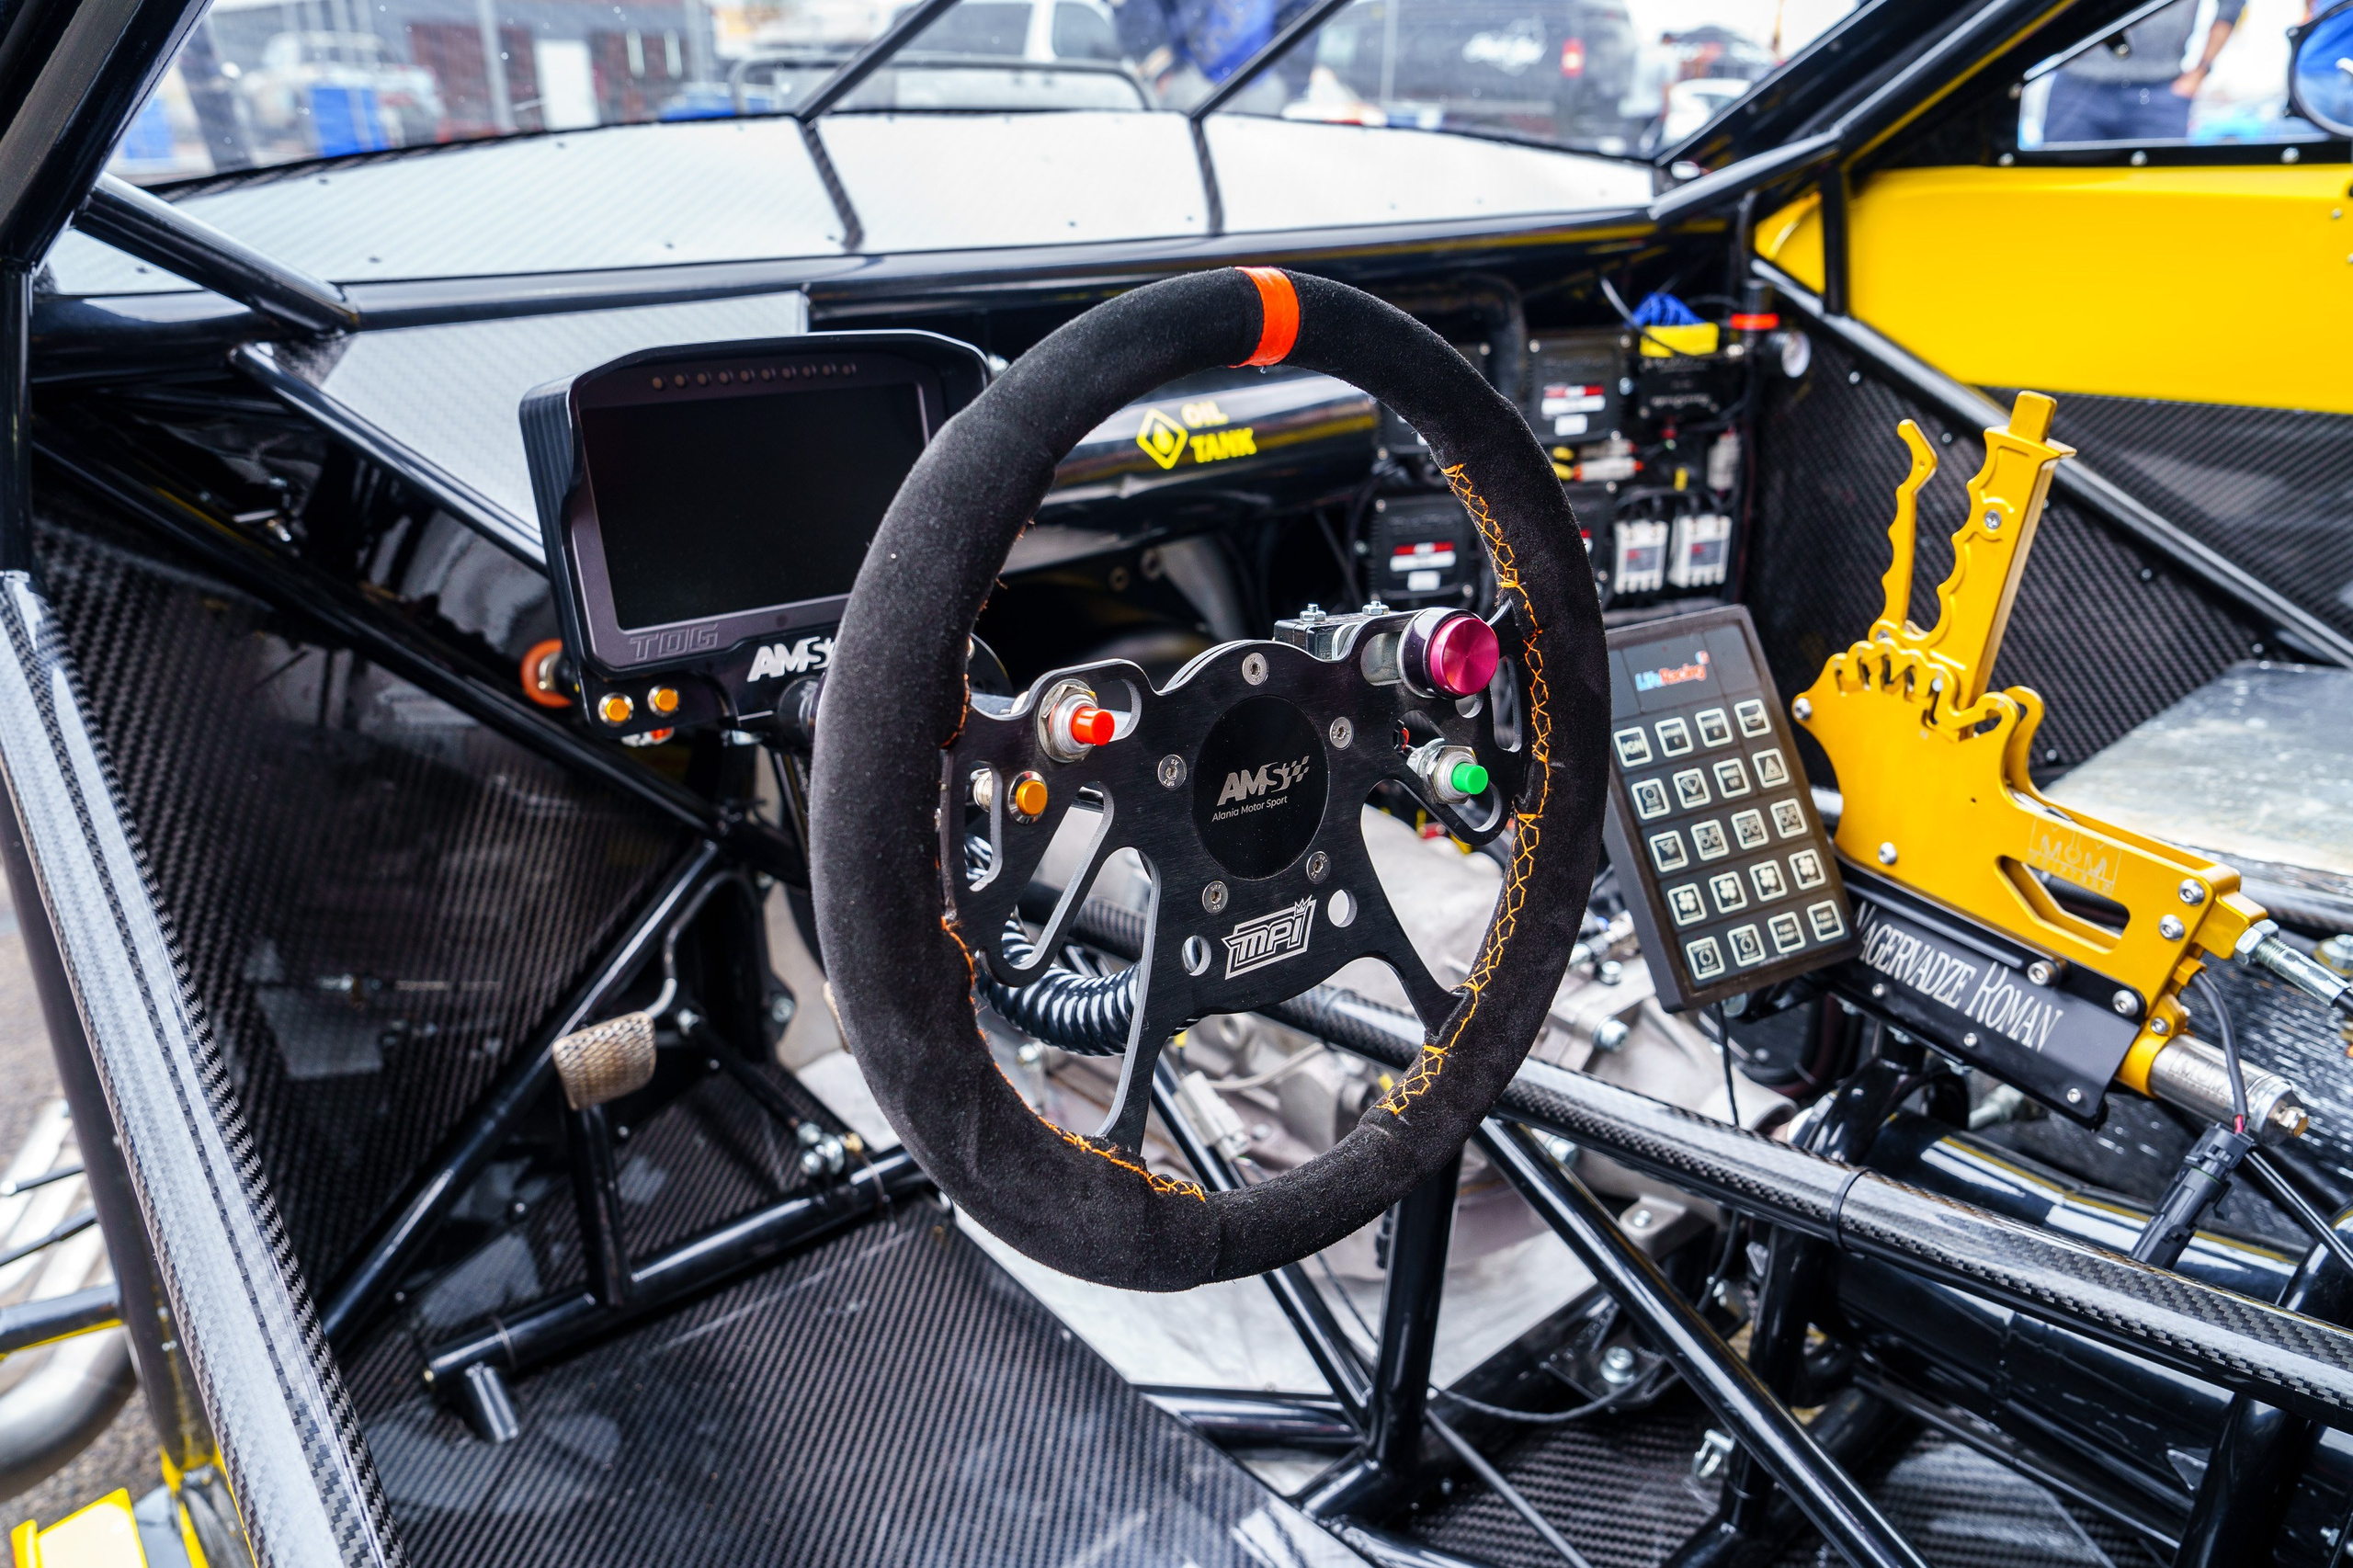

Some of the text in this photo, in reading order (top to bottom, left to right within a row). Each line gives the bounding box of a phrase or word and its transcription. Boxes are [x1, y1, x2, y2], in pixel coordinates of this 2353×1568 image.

[1181, 401, 1229, 428] OIL
[1189, 427, 1257, 463] TANK
[747, 636, 835, 682] AMS
[1621, 739, 1645, 756] IGN
[1217, 761, 1292, 806] AMS
[1211, 796, 1288, 822] Alania Motor Sport
[1856, 901, 2063, 1053] NAGERVADZE ROMAN
